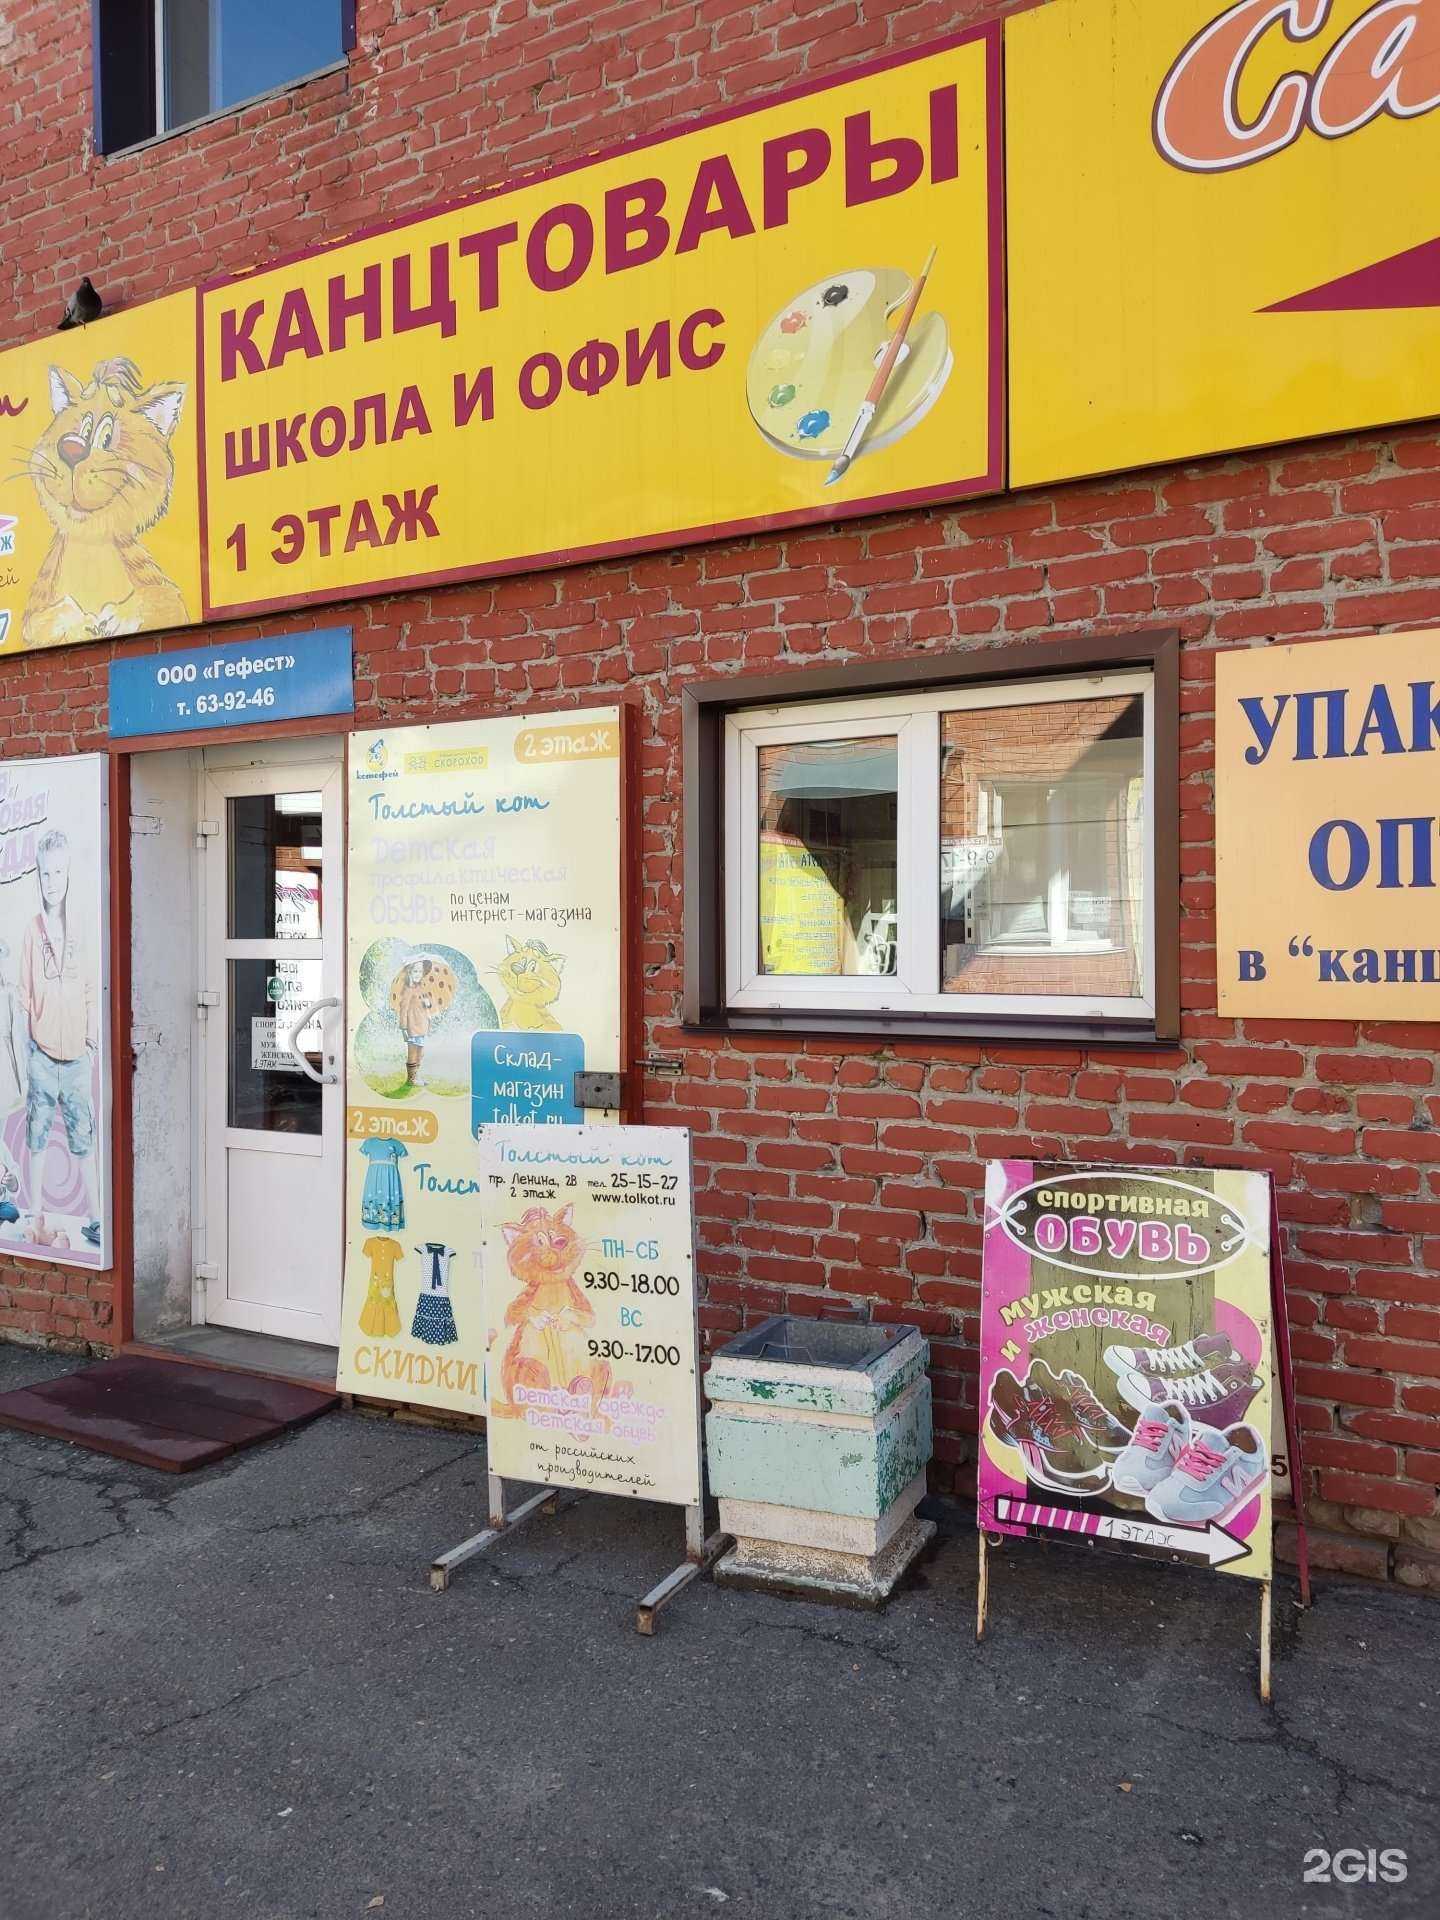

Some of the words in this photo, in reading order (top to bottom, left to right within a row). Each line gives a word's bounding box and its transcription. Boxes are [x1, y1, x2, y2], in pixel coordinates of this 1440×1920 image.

[220, 83, 960, 382] КАНЦТОВАРЫ
[224, 384, 432, 481] ШКОЛА
[453, 366, 495, 427] И
[518, 308, 726, 411] ОФИС
[226, 523, 248, 572] 1
[270, 484, 441, 566] ЭТАЖ
[157, 664, 197, 686] ООО
[203, 656, 295, 679] «Гефест»
[177, 702, 191, 716] т.
[196, 687, 275, 714] 63-92-46
[524, 733, 537, 757] 2
[541, 729, 612, 754] этаж
[368, 792, 484, 821] Толстый
[496, 794, 550, 815] кот
[1308, 816, 1440, 891] ОП
[450, 892, 464, 904] по
[469, 892, 510, 908] ценам
[450, 907, 592, 928] интернет-магазина
[1238, 949, 1267, 982] в
[494, 1044, 563, 1071] Склад-
[493, 1081, 564, 1108] магазин
[352, 1110, 365, 1133] 2
[368, 1112, 431, 1137] этаж
[496, 1139, 610, 1164] Толстый
[621, 1154, 673, 1167] кот
[488, 1174, 506, 1188] пр.
[511, 1173, 560, 1187] Ленина,
[611, 1172, 679, 1191] 25-15-27
[510, 1187, 517, 1198] 2
[522, 1188, 557, 1199] этаж
[592, 1193, 676, 1206] www.tolkot.ru
[602, 1238, 659, 1260] ПН-СБ
[1034, 1213, 1211, 1265] ОБУВЬ
[583, 1271, 680, 1296] 9.30-18.00
[620, 1307, 643, 1328] ВС
[353, 1345, 479, 1396] СКИДКИ
[529, 1442, 550, 1452] от
[537, 1459, 657, 1487] производителей
[1105, 1519, 1114, 1540] 1
